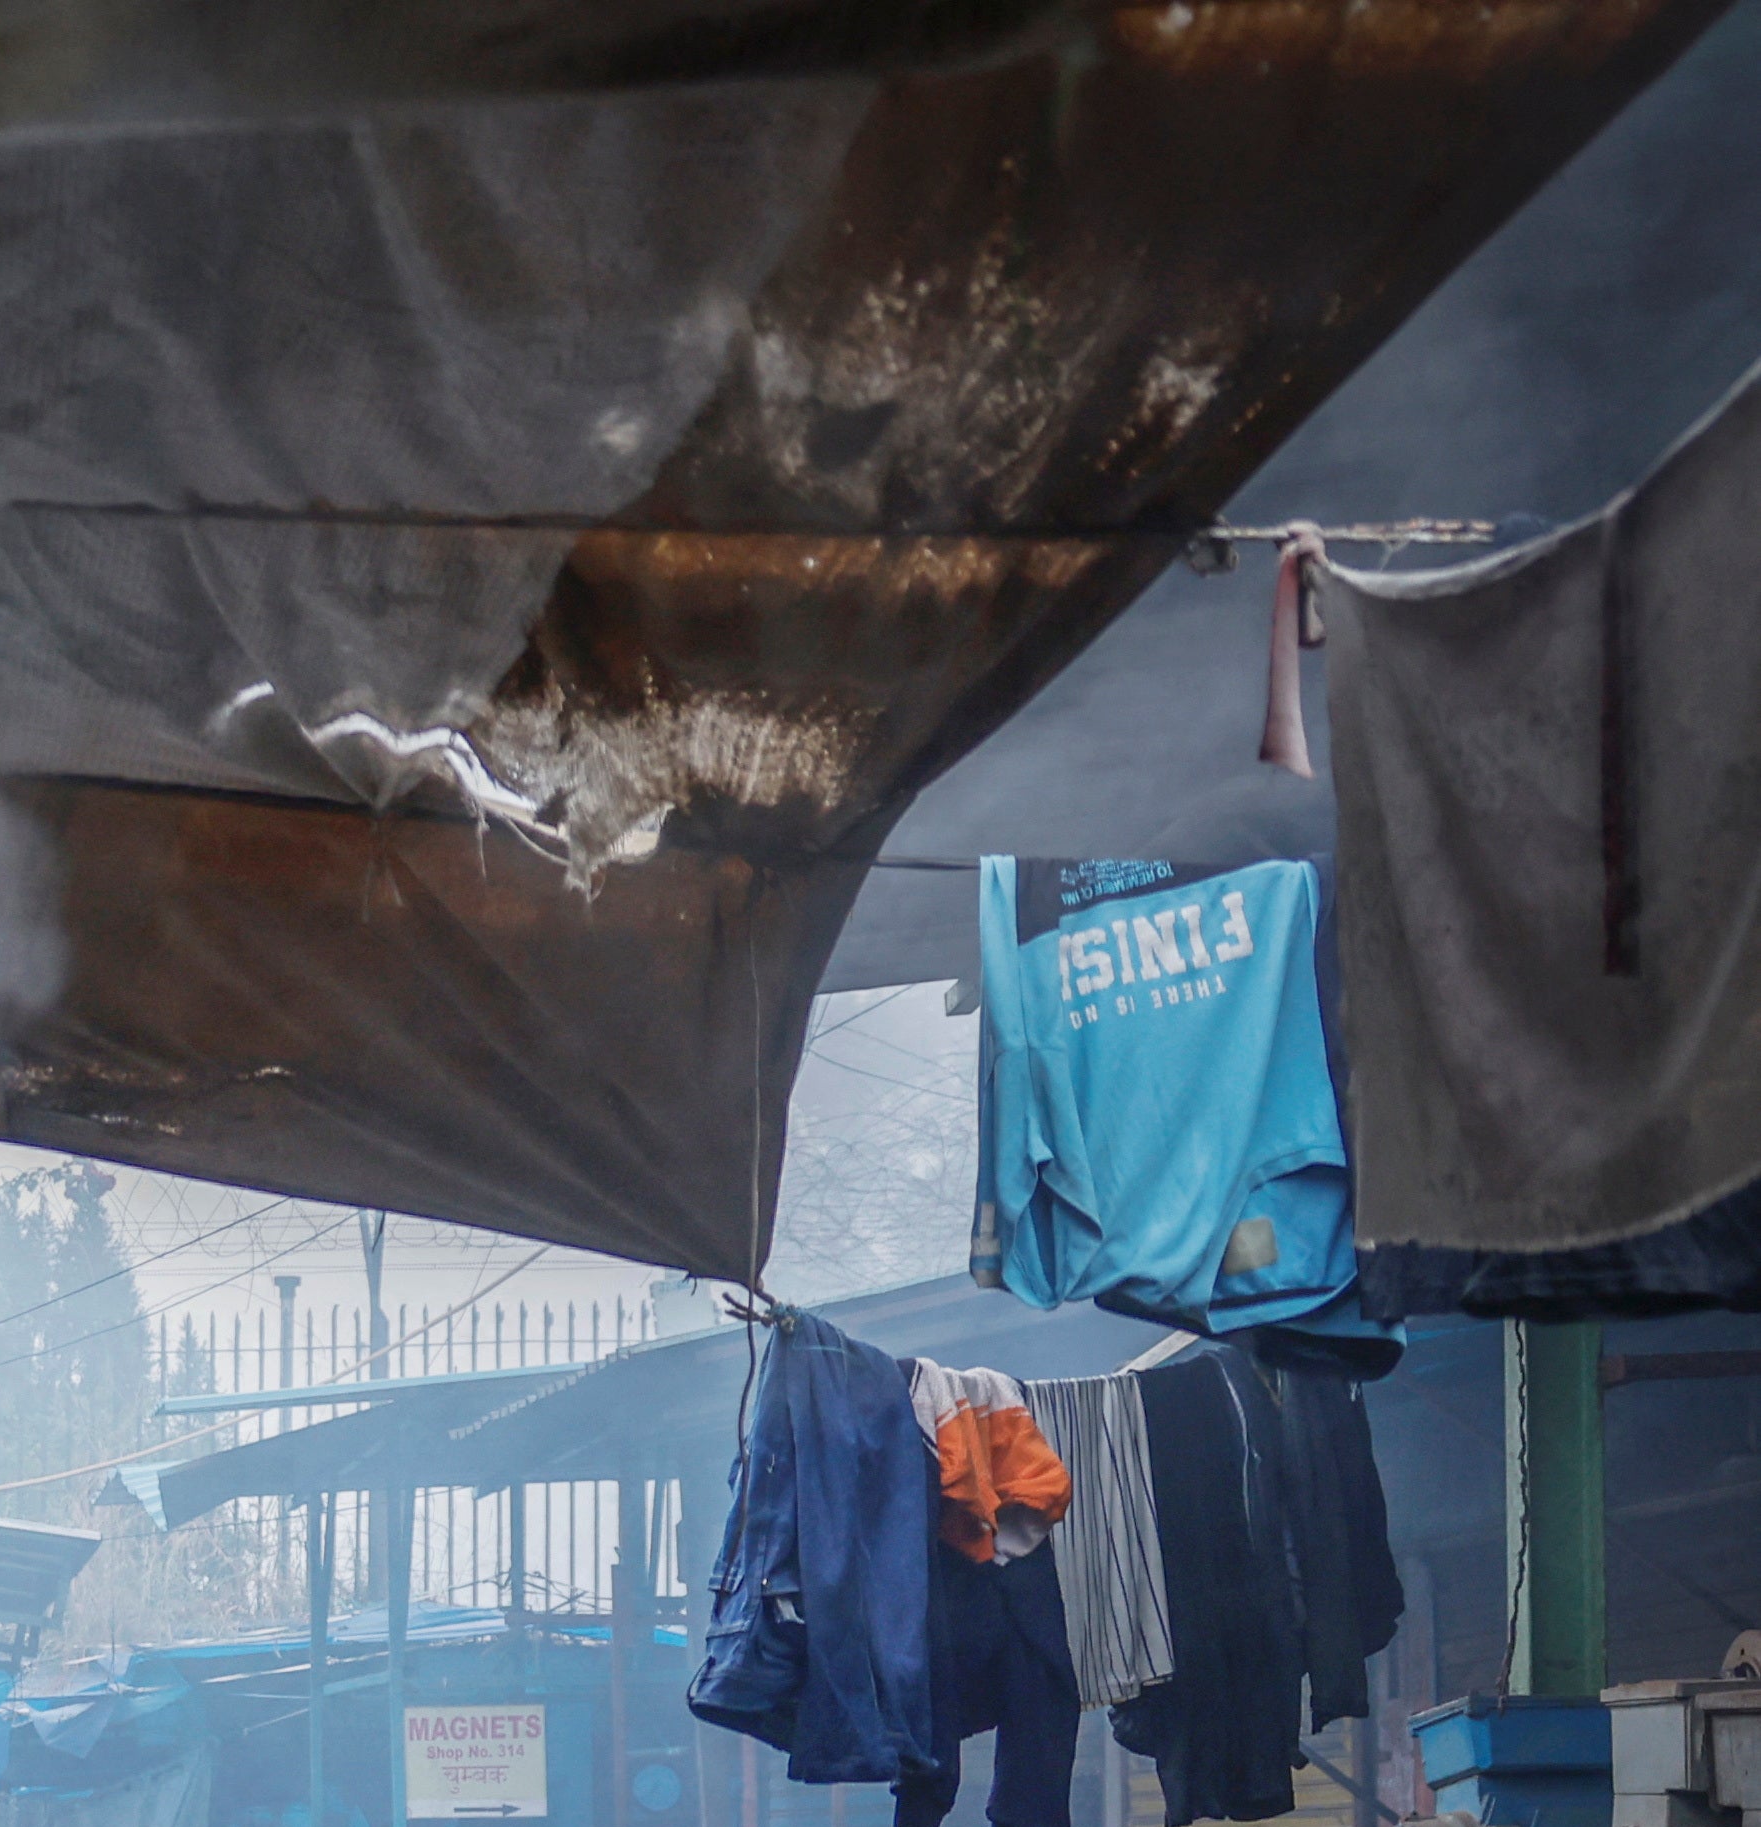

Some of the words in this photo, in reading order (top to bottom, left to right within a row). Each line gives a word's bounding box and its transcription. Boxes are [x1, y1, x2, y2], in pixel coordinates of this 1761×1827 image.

[1149, 974, 1227, 1009] THERE
[1068, 1003, 1099, 1031] NO
[1115, 995, 1135, 1016] IS
[408, 1714, 542, 1741] MAGNETS
[426, 1745, 464, 1761] Shop
[468, 1745, 492, 1758] No.
[498, 1743, 525, 1758] 314
[442, 1765, 510, 1795] चुम्बक
